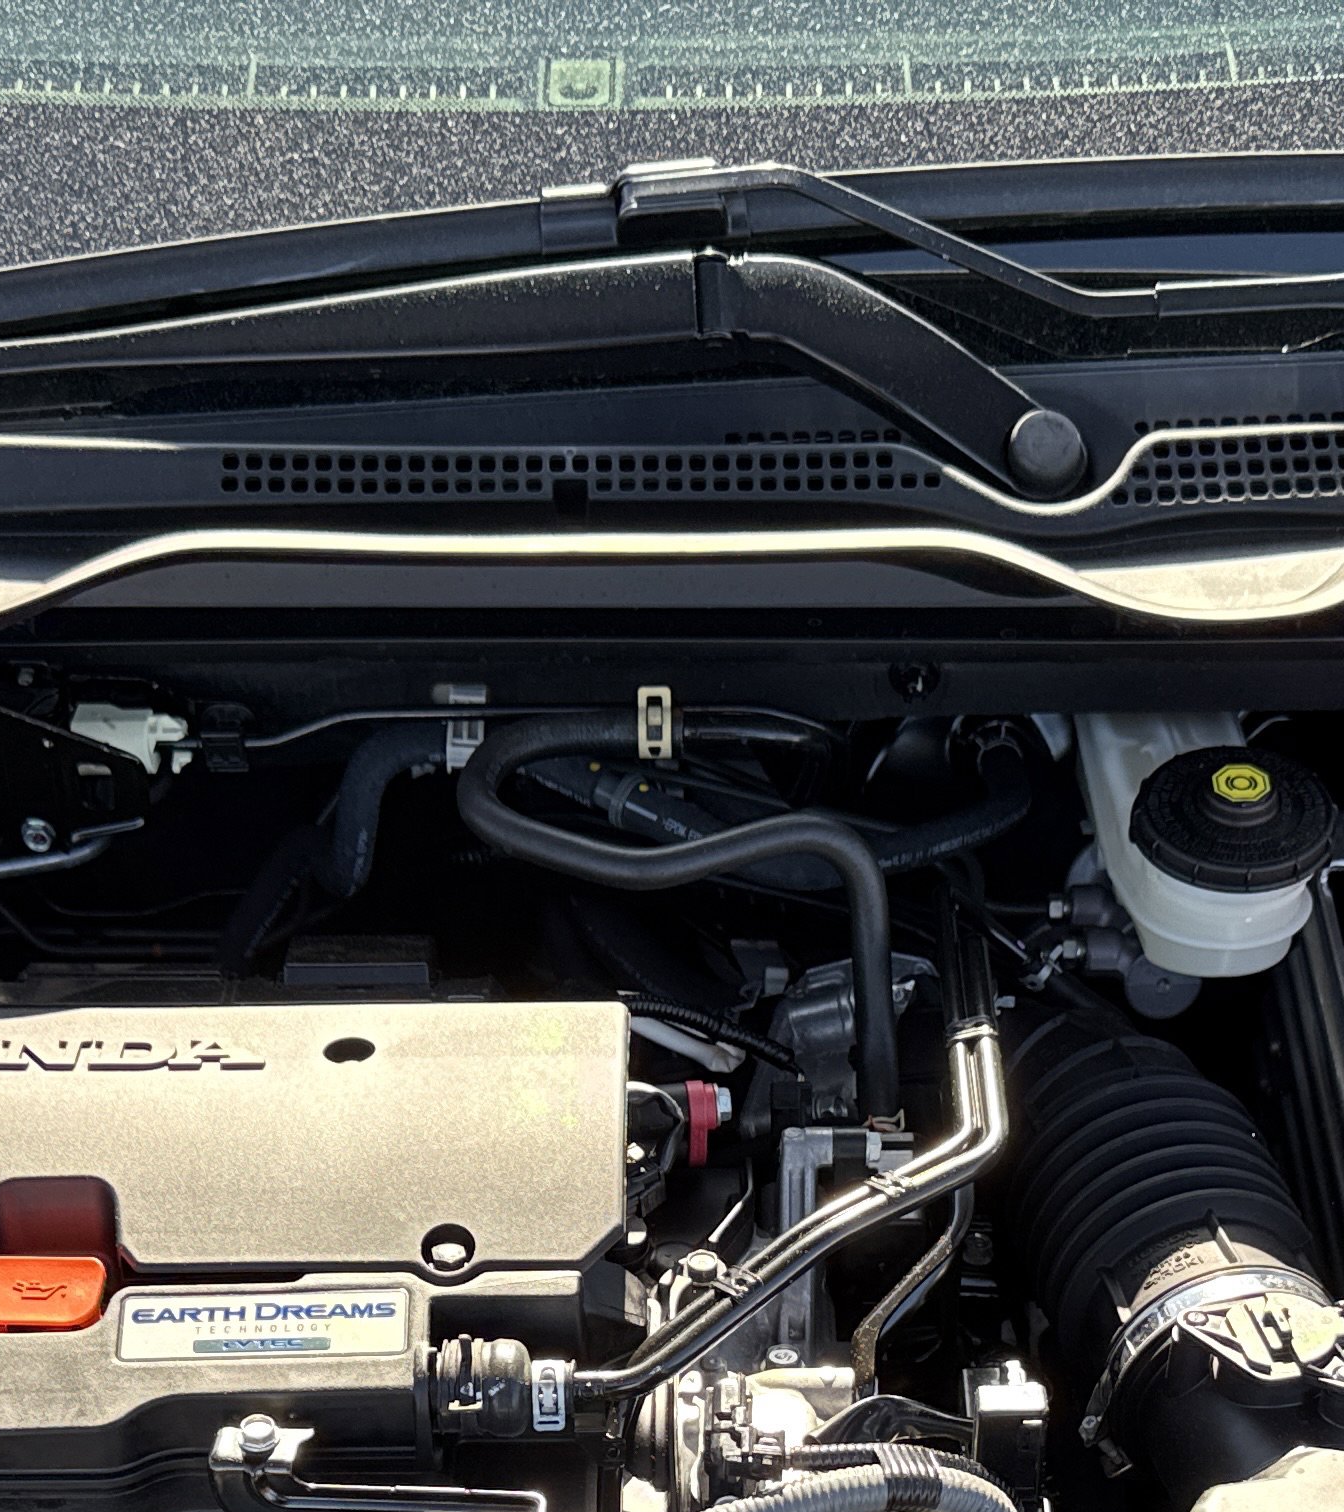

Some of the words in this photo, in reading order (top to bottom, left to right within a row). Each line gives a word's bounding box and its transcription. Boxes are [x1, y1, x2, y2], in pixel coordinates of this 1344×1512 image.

[132, 1306, 246, 1324] EARTH
[255, 1302, 397, 1322] DREAMS
[195, 1323, 332, 1335] TECHNOLOGY
